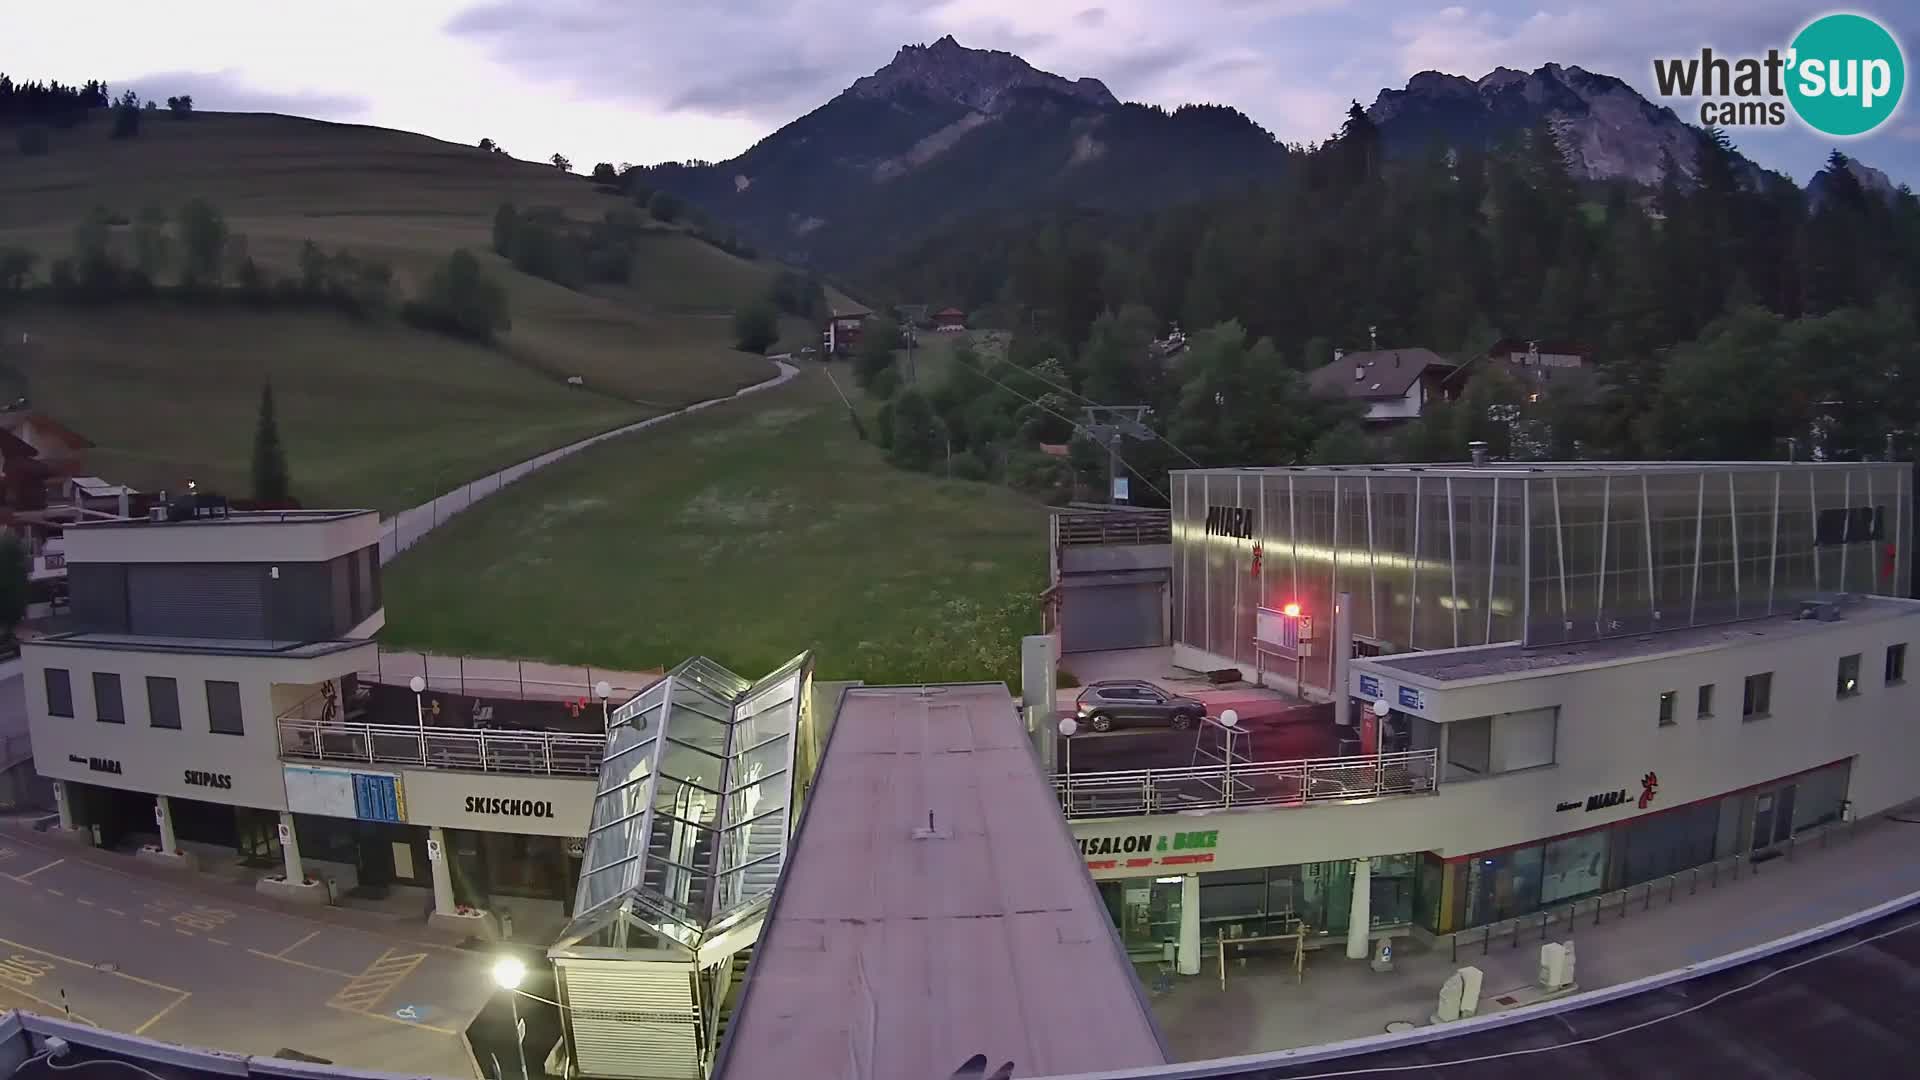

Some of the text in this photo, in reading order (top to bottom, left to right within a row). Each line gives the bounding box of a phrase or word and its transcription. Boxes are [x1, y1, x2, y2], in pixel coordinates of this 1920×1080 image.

[1205, 505, 1253, 540] MIARA
[184, 769, 232, 790] SKIPASS
[465, 796, 554, 819] SKISCHOOL
[1077, 834, 1153, 856] ISALON
